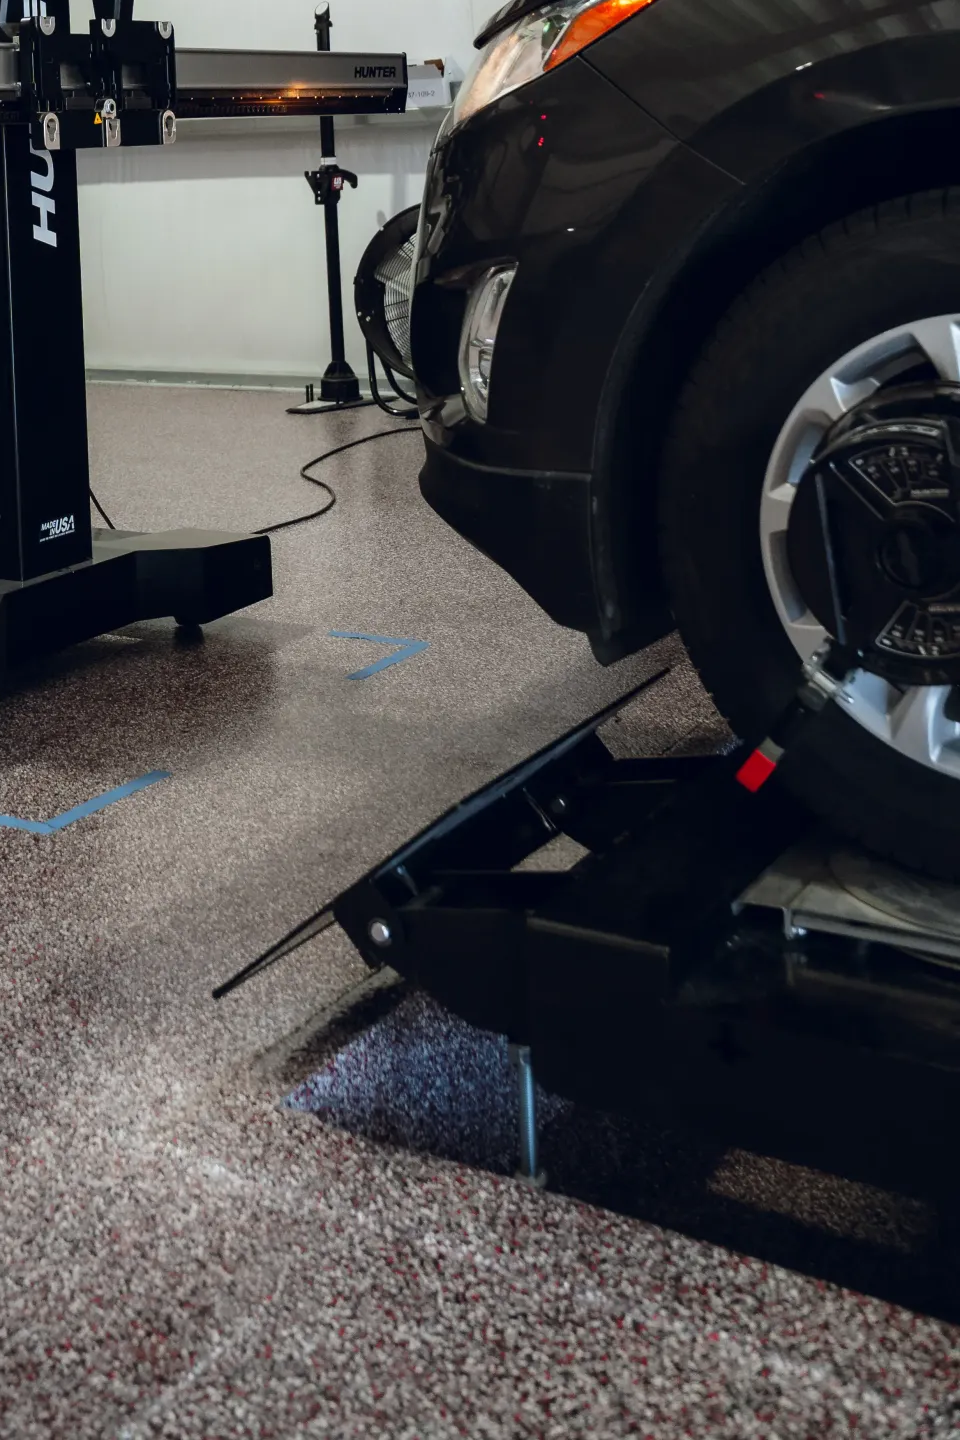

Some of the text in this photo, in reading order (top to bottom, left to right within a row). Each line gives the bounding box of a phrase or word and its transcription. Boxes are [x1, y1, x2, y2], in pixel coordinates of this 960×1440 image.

[354, 66, 396, 78] HUNTER
[41, 520, 56, 531] MADE
[55, 515, 75, 534] USA
